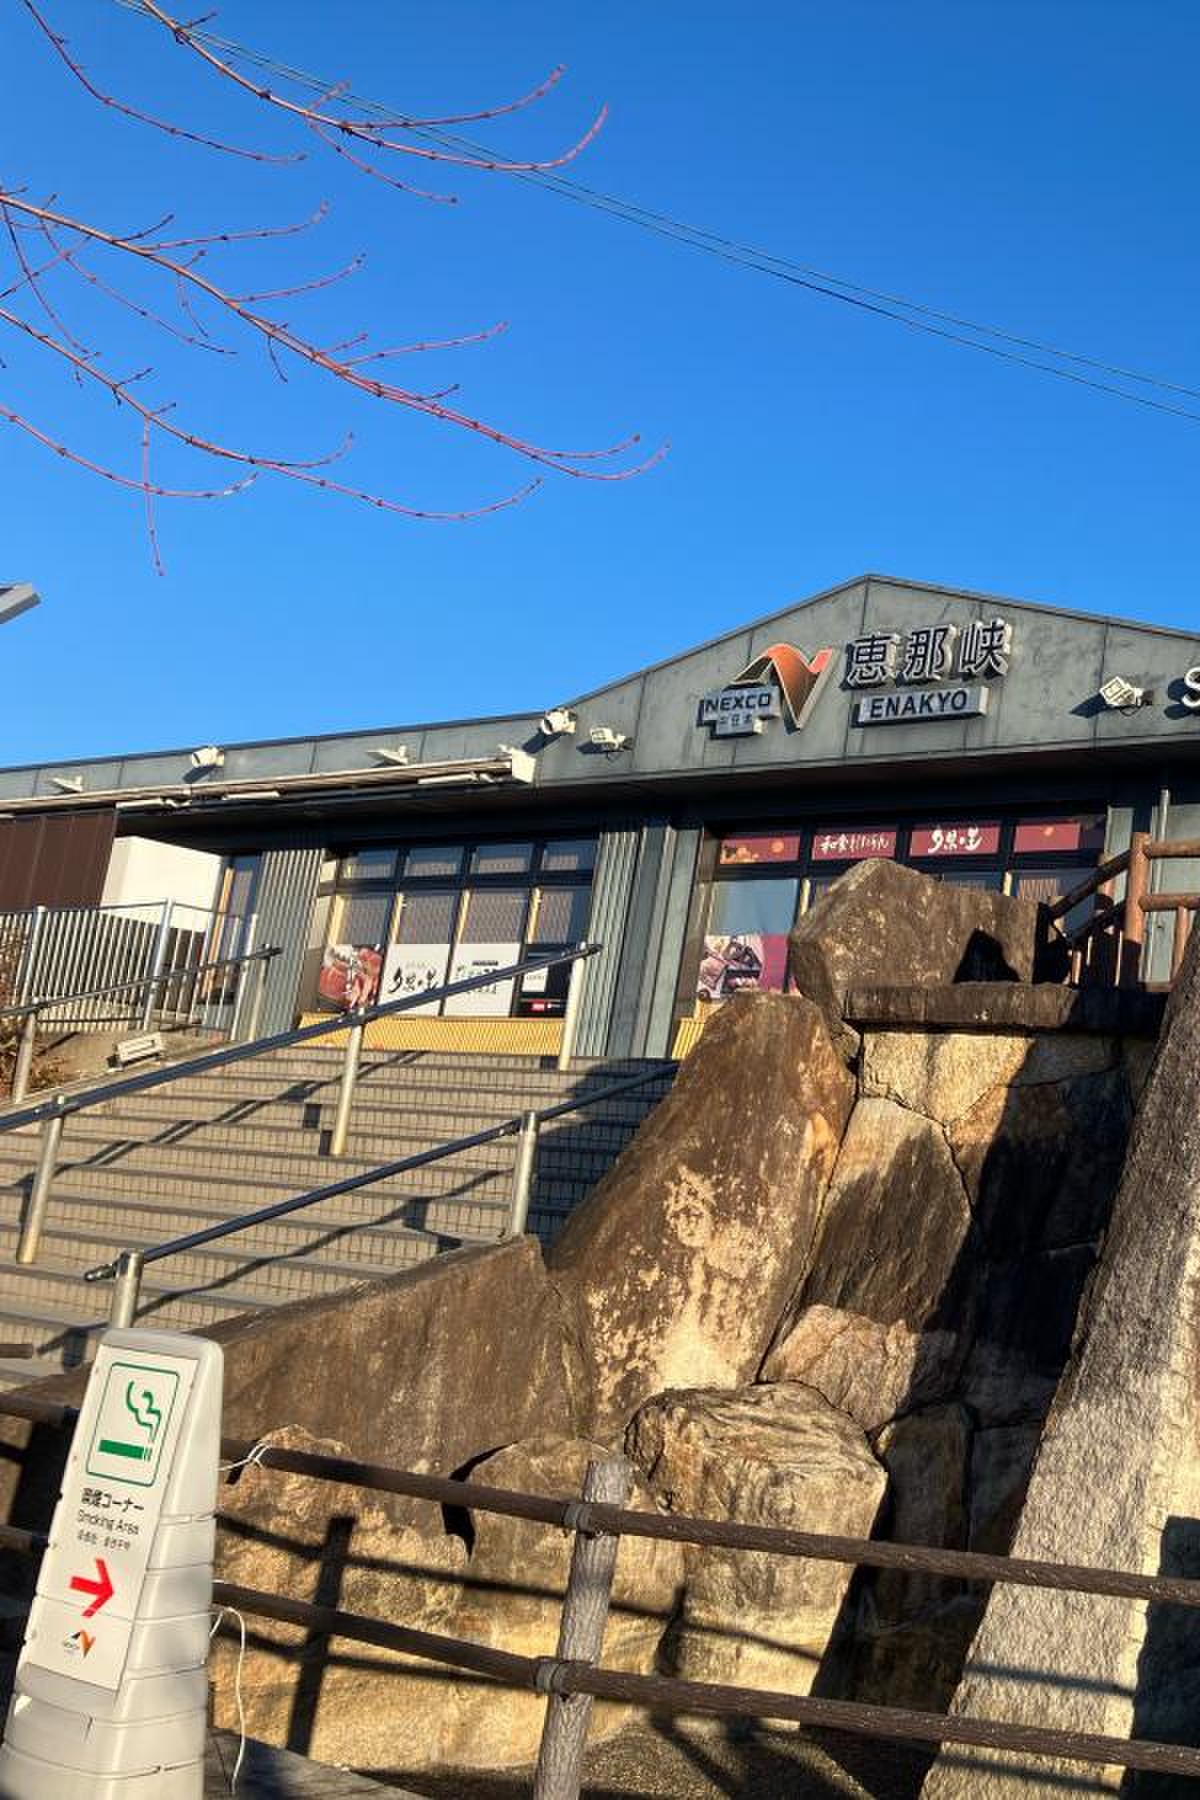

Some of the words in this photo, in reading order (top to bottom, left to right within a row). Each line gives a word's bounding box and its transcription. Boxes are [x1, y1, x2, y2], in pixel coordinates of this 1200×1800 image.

[846, 618, 1011, 688] 恵那峡
[704, 692, 771, 713] NEXCO
[870, 690, 968, 718] ENAKYO
